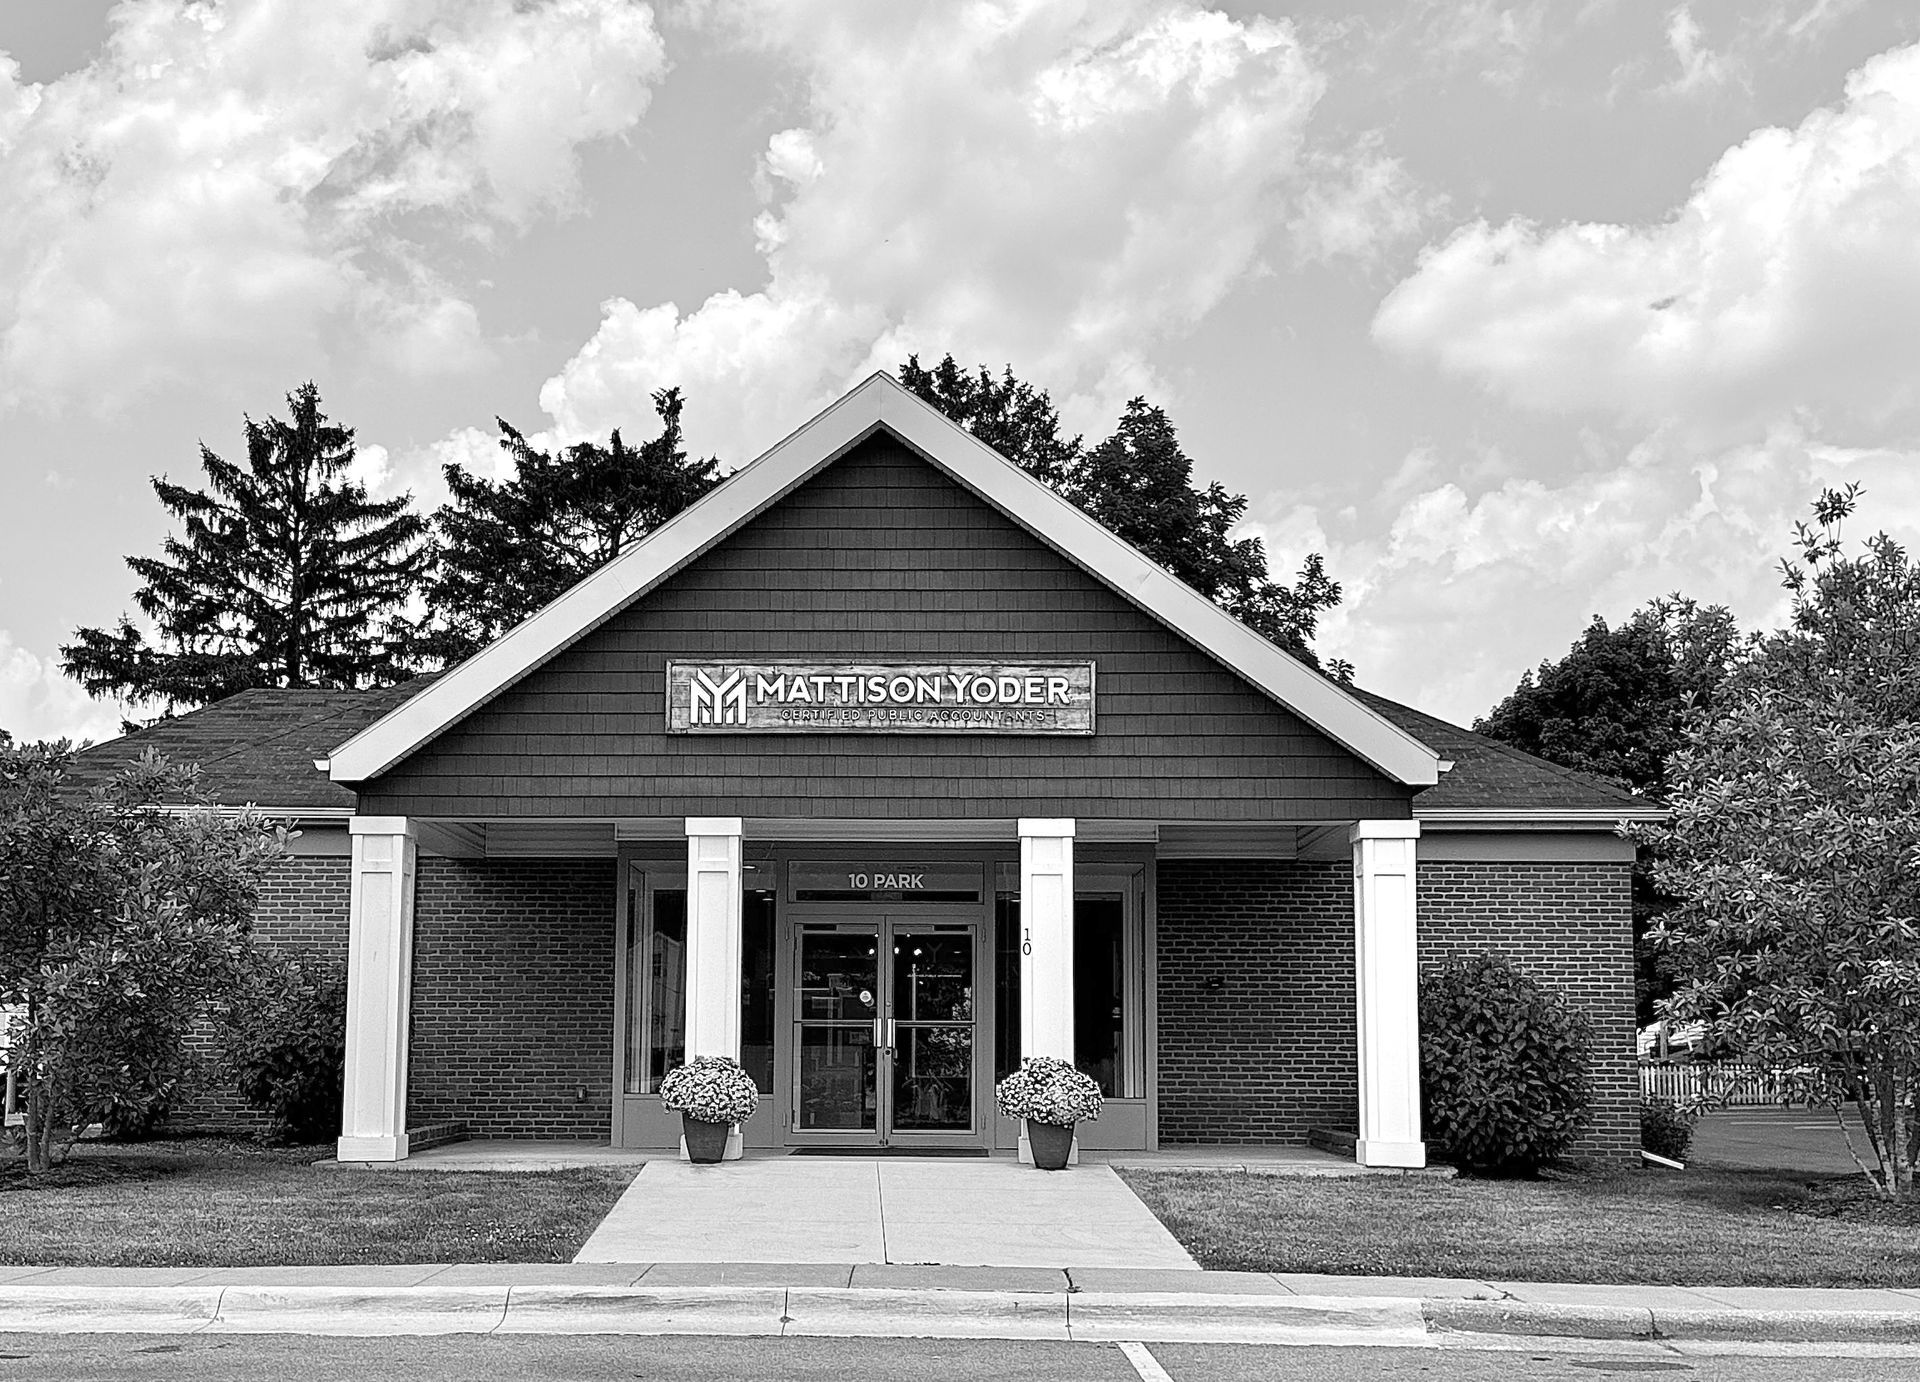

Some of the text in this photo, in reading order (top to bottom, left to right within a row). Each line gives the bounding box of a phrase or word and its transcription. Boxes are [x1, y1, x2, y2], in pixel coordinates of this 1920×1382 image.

[756, 674, 1070, 704] MATTISON YODER
[781, 709, 1045, 721] CERTIFIED PUBLIC ACCOUNTANTS
[848, 873, 924, 888] 10 PARK
